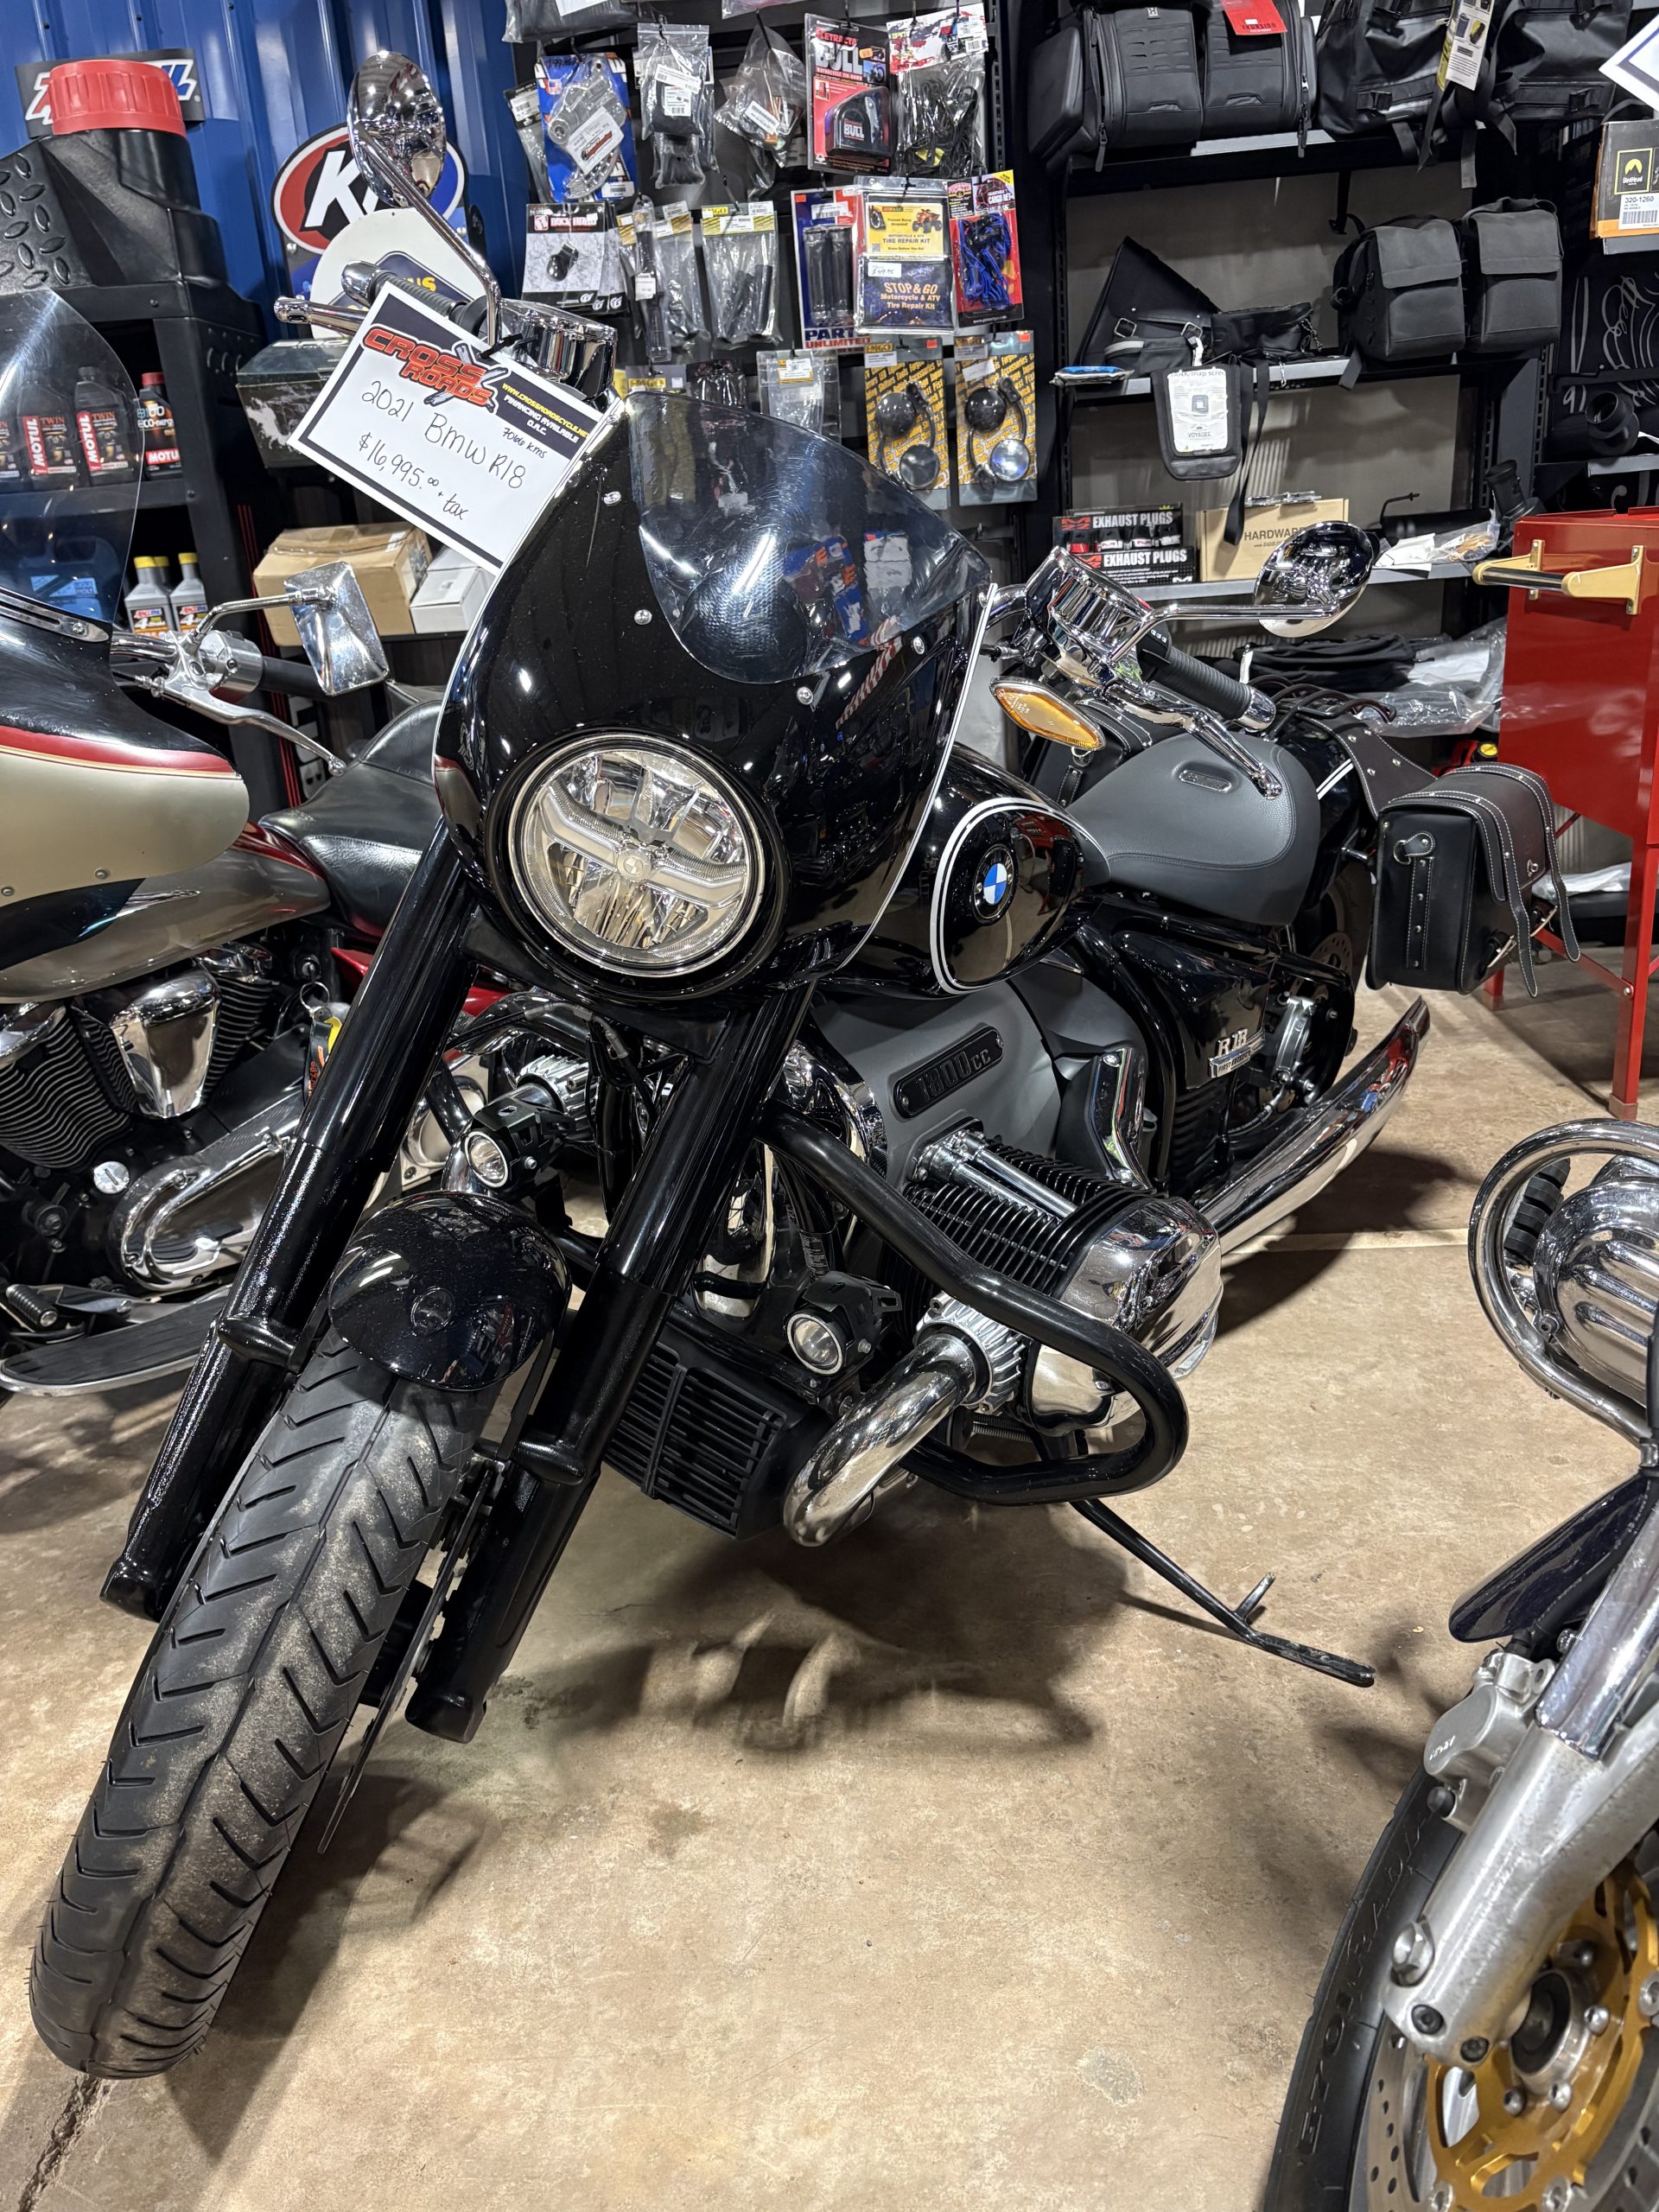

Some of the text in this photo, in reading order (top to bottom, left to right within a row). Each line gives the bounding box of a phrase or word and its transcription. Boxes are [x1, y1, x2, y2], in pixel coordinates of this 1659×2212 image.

[843, 123, 864, 138] BULL
[880, 292, 918, 302] Motorcycle
[926, 294, 941, 302] ATV
[883, 282, 938, 296] STOP & GO
[901, 302, 925, 310] Repair
[804, 327, 855, 341] PART
[804, 336, 871, 349] UNLIMITED
[365, 328, 486, 385] CROSS
[402, 363, 493, 406] ROADS
[361, 380, 415, 423] 2021
[40, 416, 66, 425] TWIN
[92, 411, 116, 421] TWIN
[504, 394, 580, 444] FINANCING AVAILABLE
[26, 418, 46, 467] MOTUL
[79, 414, 100, 463] MOTUL
[148, 449, 181, 462] MOTU
[488, 454, 527, 490] R18
[442, 493, 469, 520] tax
[1092, 512, 1173, 529] EXHAUST PLUGS
[1244, 526, 1307, 541] HARDWAR
[1103, 549, 1187, 568] EXHAUST PLUGS
